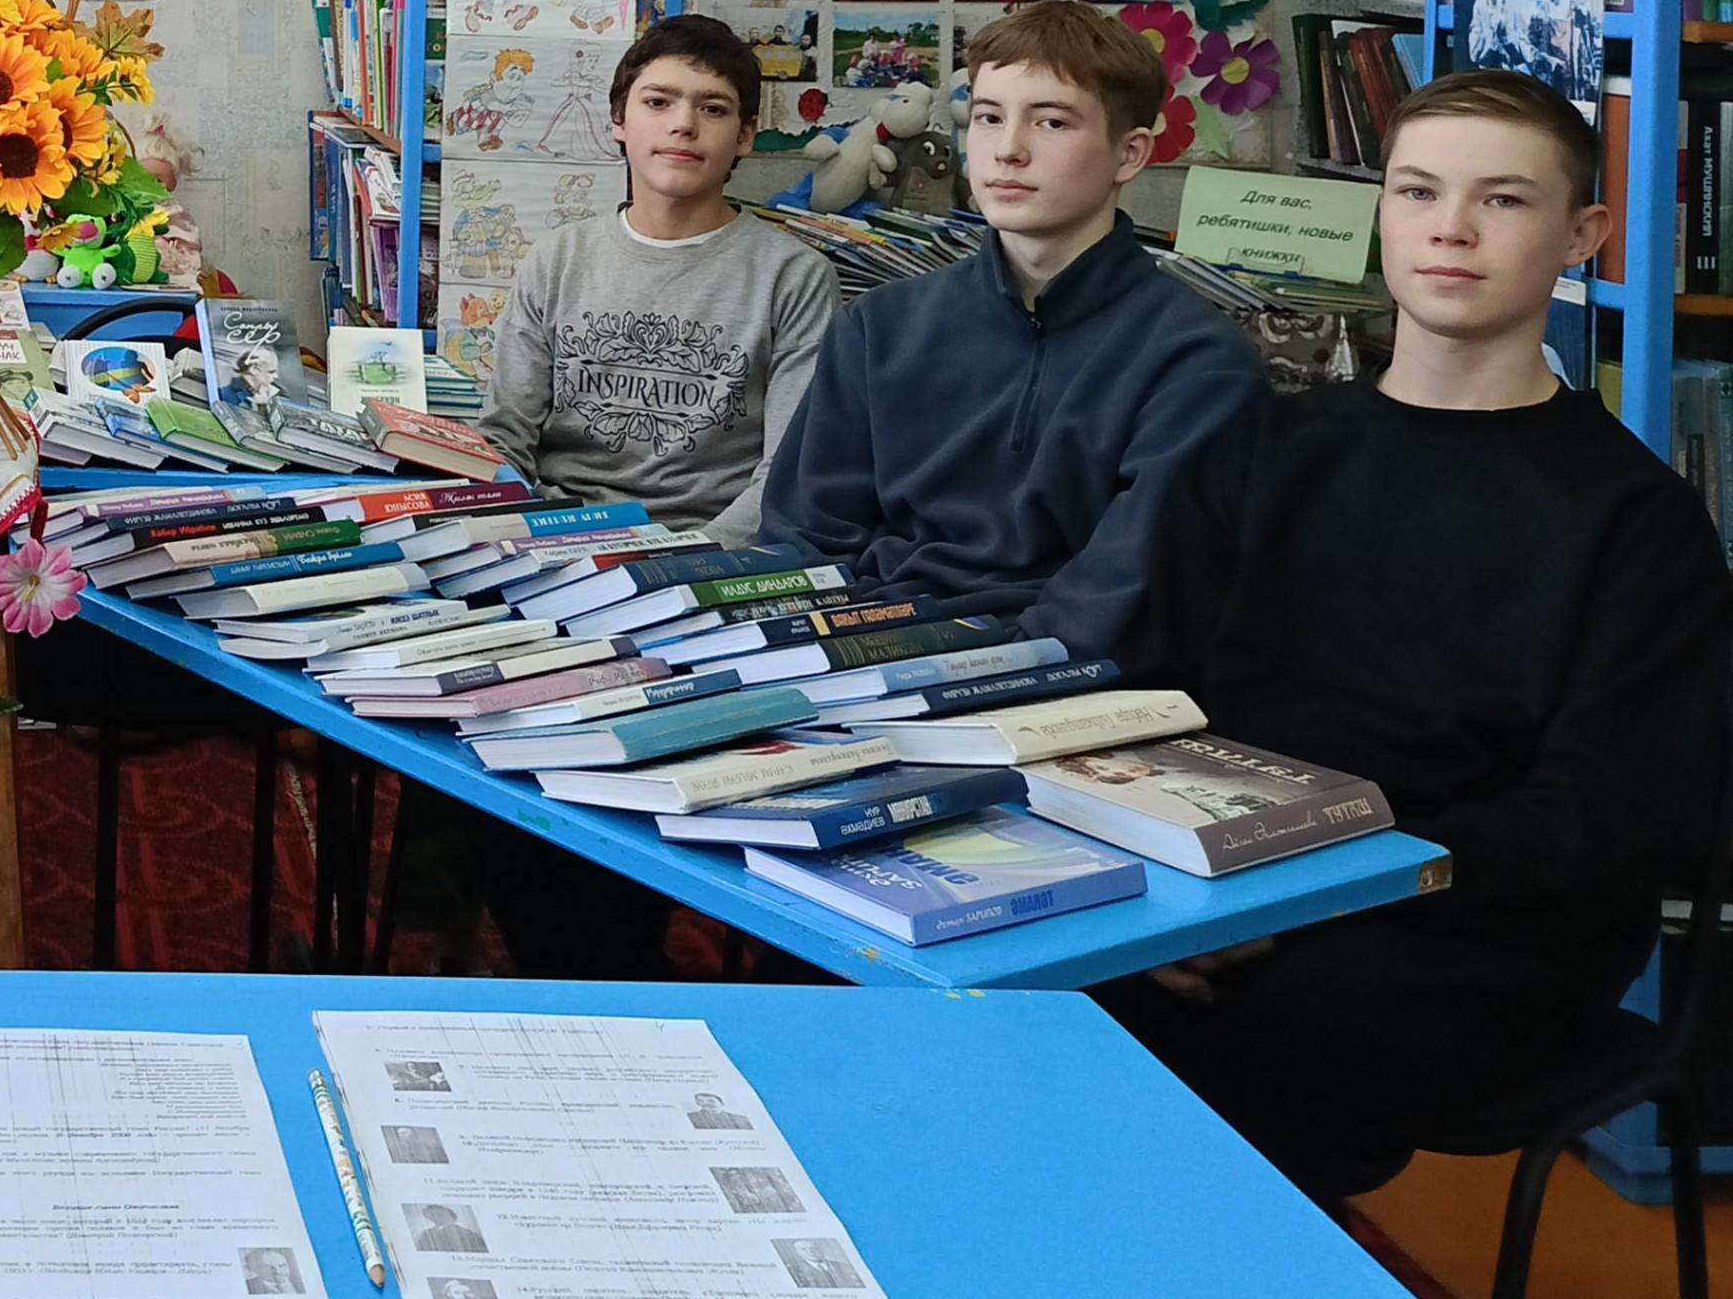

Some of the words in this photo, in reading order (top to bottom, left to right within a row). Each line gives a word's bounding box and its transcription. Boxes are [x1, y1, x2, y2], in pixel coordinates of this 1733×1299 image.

[1240, 189, 1276, 208] Для
[1280, 194, 1312, 211] вас,
[1197, 213, 1293, 237] ребятишки,
[1297, 227, 1353, 243] новые
[1241, 247, 1301, 263] книжки
[578, 369, 716, 409] INSPIRATION
